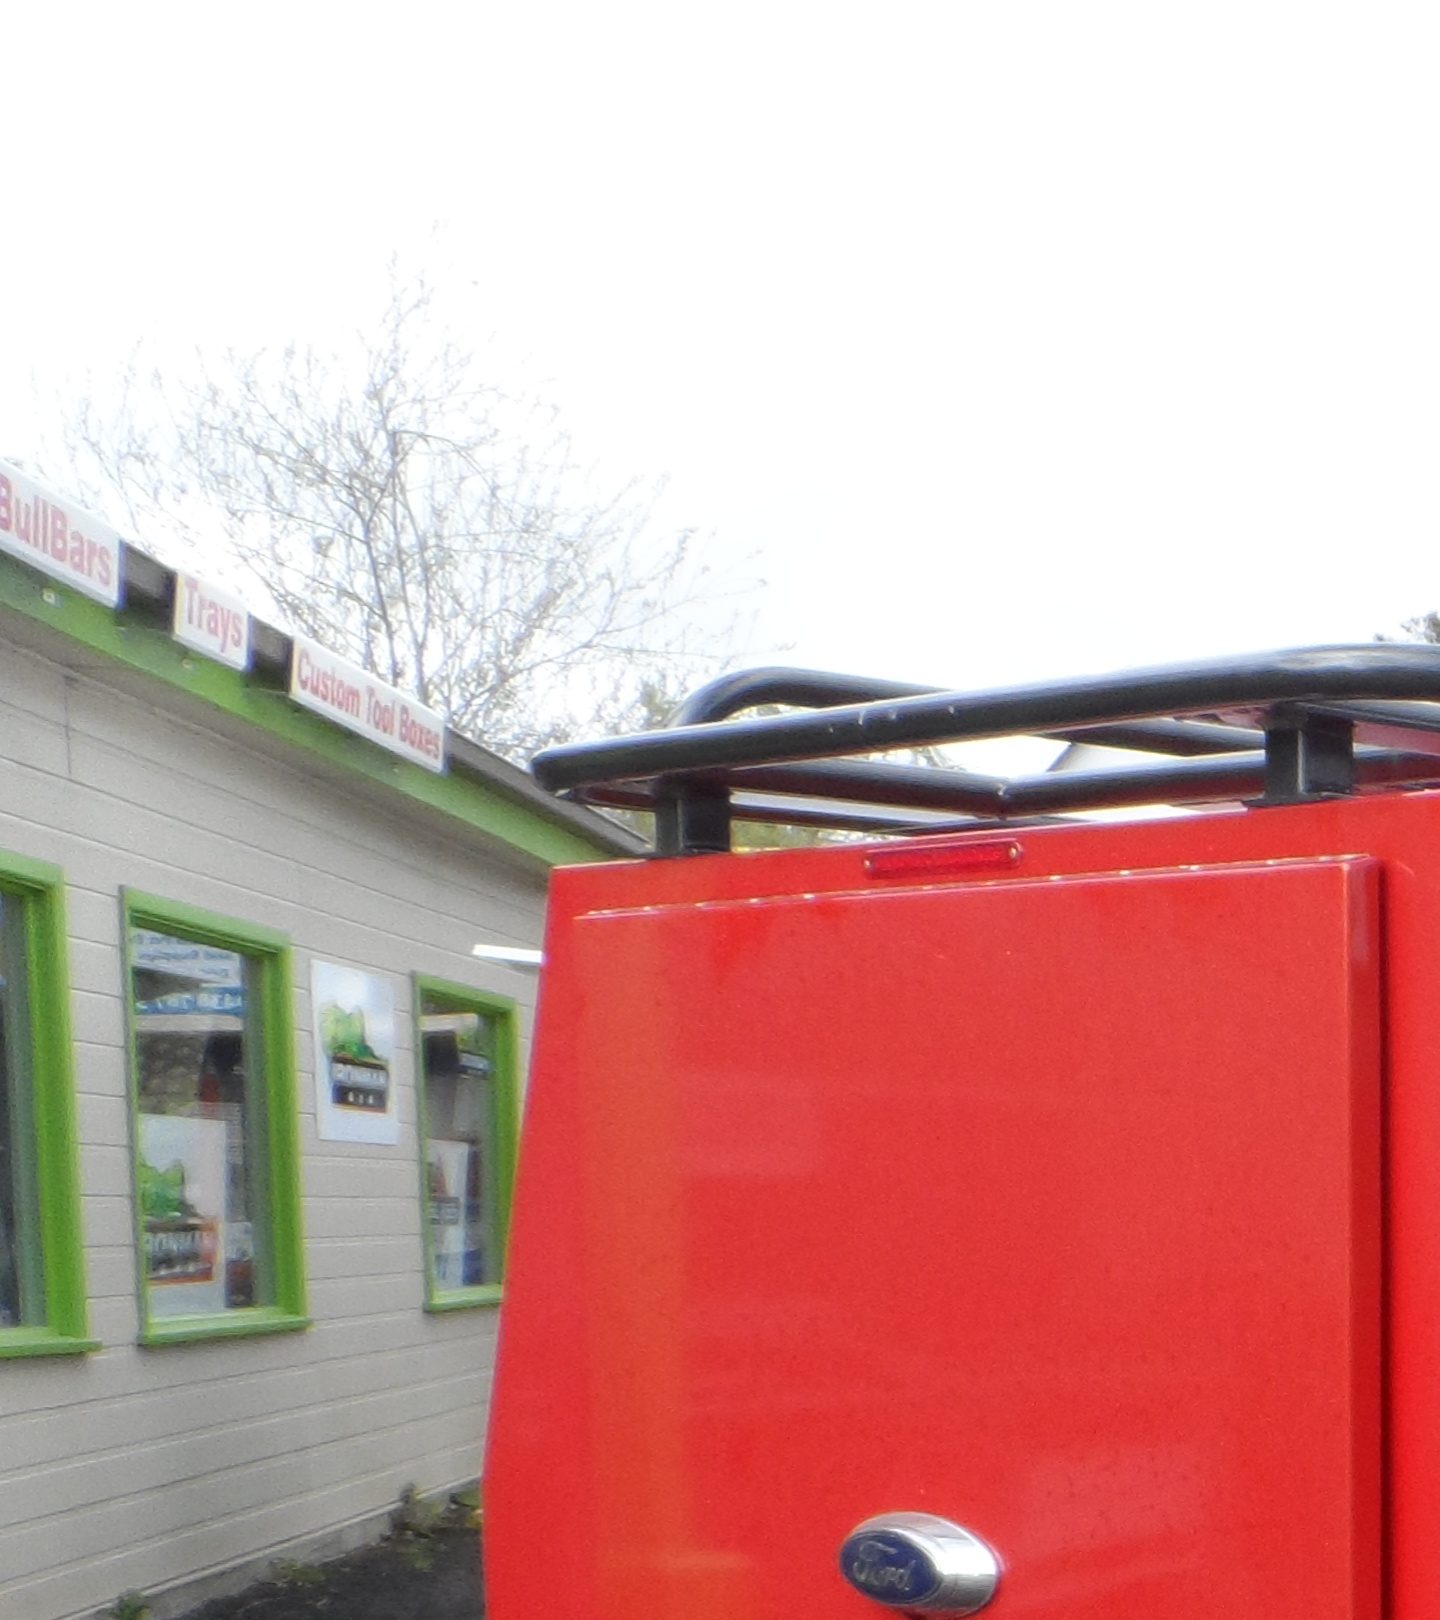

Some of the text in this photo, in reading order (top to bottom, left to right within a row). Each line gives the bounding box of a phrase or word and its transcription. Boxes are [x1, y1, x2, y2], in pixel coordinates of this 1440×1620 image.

[184, 576, 242, 652] Trays
[299, 649, 440, 760] Custom Tool Boxes
